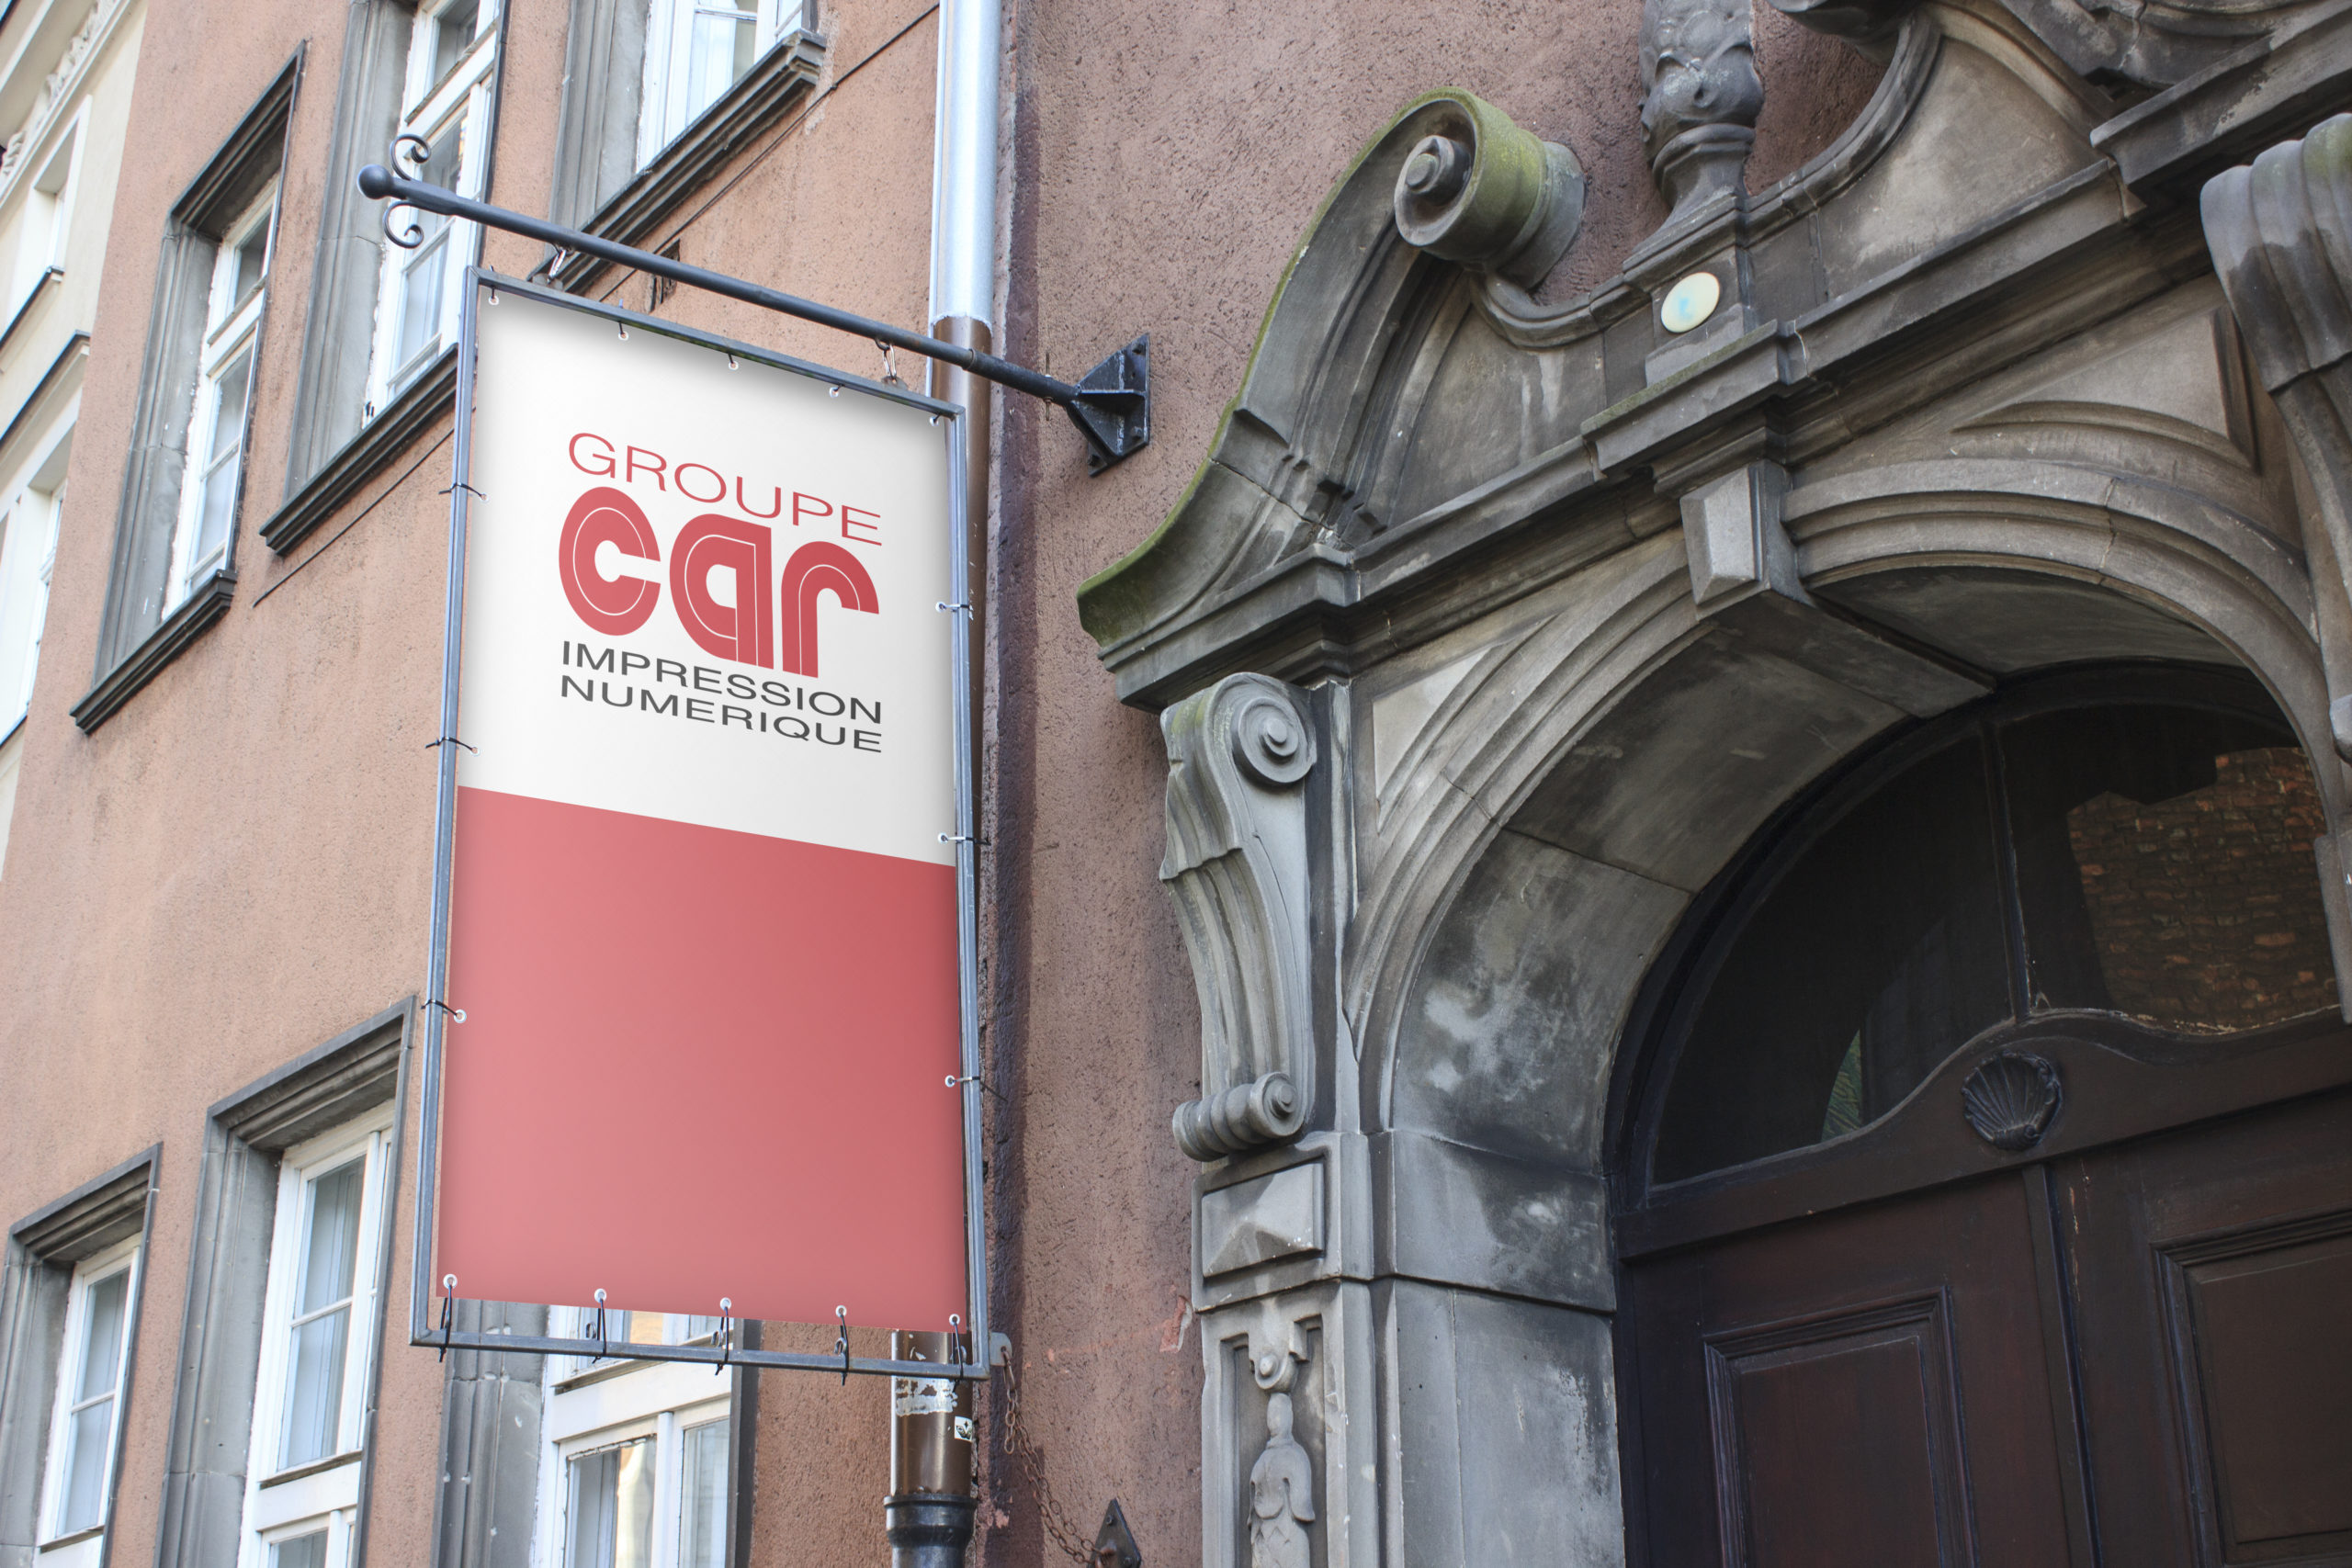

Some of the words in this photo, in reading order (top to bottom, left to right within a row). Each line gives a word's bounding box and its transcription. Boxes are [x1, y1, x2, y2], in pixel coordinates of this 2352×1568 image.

[569, 433, 882, 547] GROUPE
[559, 486, 880, 679] car
[561, 675, 882, 753] NUMERIQUE
[562, 640, 882, 725] IMPRESSION
